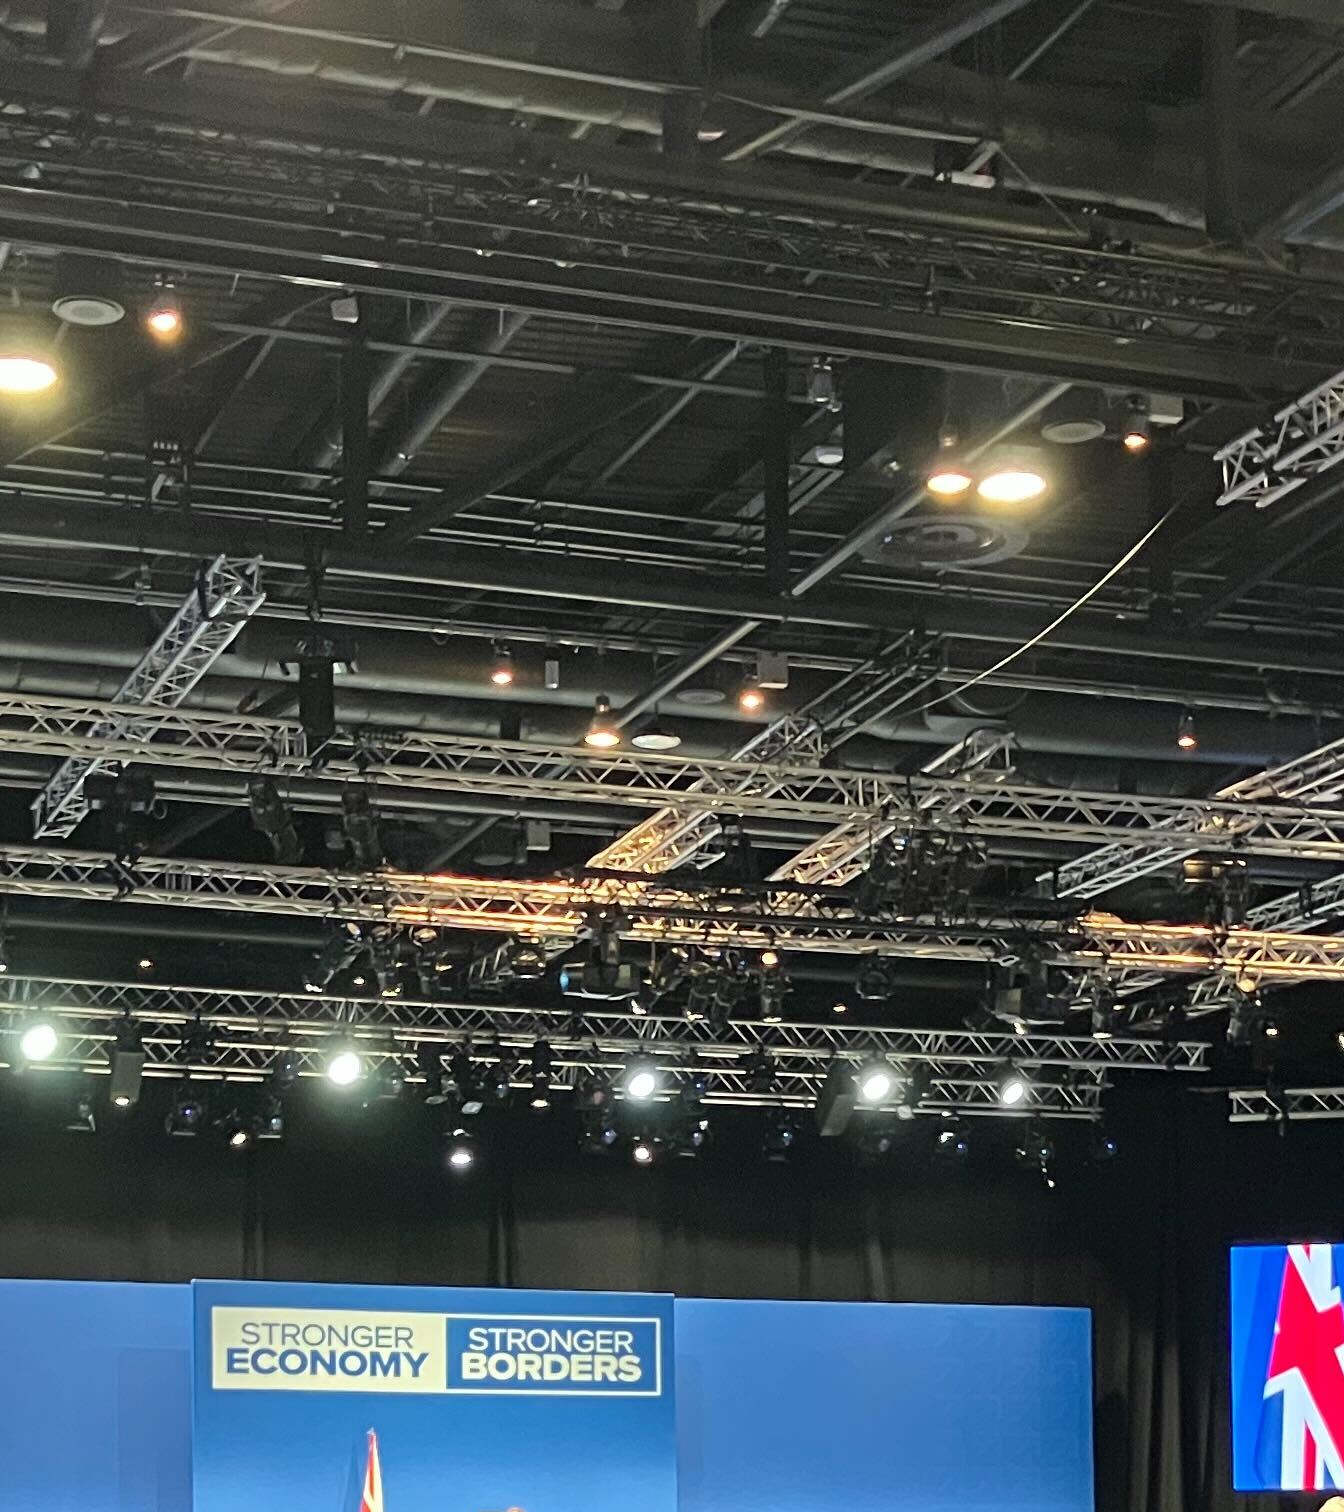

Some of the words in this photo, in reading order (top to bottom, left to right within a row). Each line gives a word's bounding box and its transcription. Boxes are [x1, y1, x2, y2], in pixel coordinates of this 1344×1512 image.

[241, 1322, 414, 1349] STRONGER
[468, 1328, 634, 1353] STRONGER
[226, 1347, 430, 1378] ECONOMY
[461, 1352, 643, 1382] BORDERS
